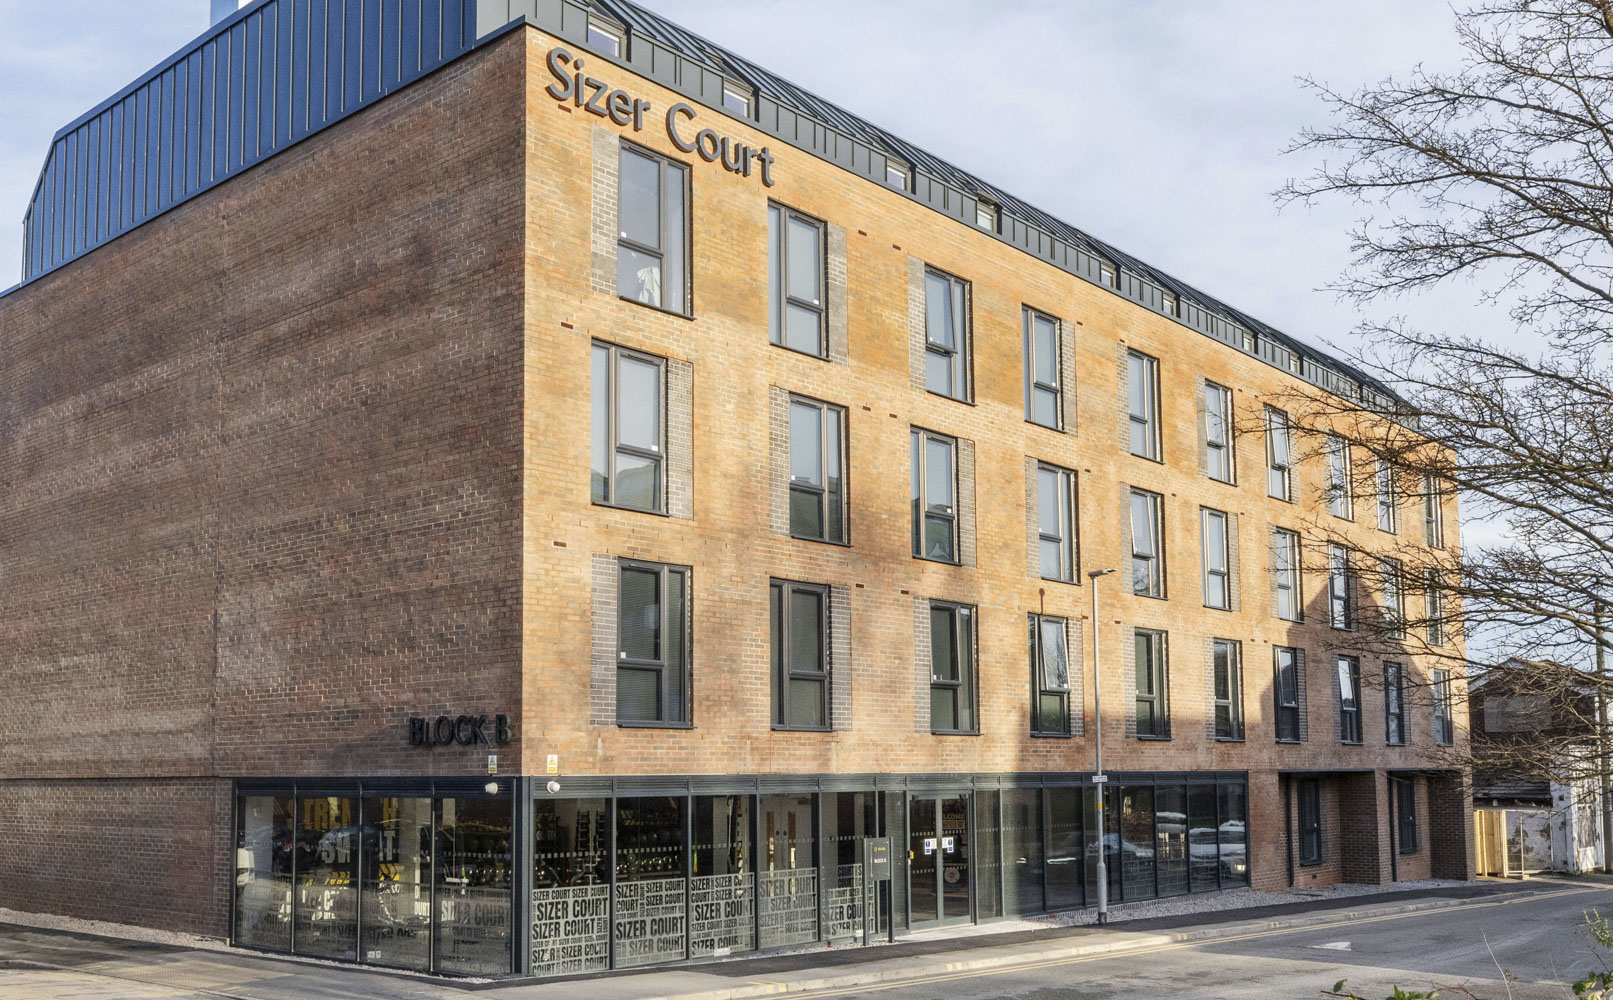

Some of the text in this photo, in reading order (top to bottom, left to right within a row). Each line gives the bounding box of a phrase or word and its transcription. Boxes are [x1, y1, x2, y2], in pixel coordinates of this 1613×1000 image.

[545, 46, 775, 188] Sizer Court
[409, 714, 512, 746] BLOCK B
[646, 880, 684, 894] SIZER COURT
[691, 878, 710, 891] SIZER
[715, 876, 732, 889] SIZER
[532, 886, 608, 902] SIZER COURT SIZER COURT
[616, 883, 639, 899] SIZER
[715, 888, 732, 901] SIZER
[734, 887, 753, 900] COT
[616, 899, 639, 912] COURT
[646, 893, 684, 906] SIZER COURT
[770, 896, 792, 912] SIZER
[537, 900, 570, 922] SIZER
[572, 898, 608, 918] COURT
[695, 902, 721, 922] SIZER
[724, 899, 753, 918] COURT
[532, 918, 596, 940] SIZER COURT
[616, 916, 684, 941] SIZER COURT
[561, 944, 584, 960] SIZER
[584, 942, 608, 957] COURT
[629, 939, 654, 957] SIZER
[657, 935, 684, 952] COURT
[532, 963, 556, 976] COURT
[561, 960, 584, 974] SIZER
[584, 956, 608, 971] COURT
